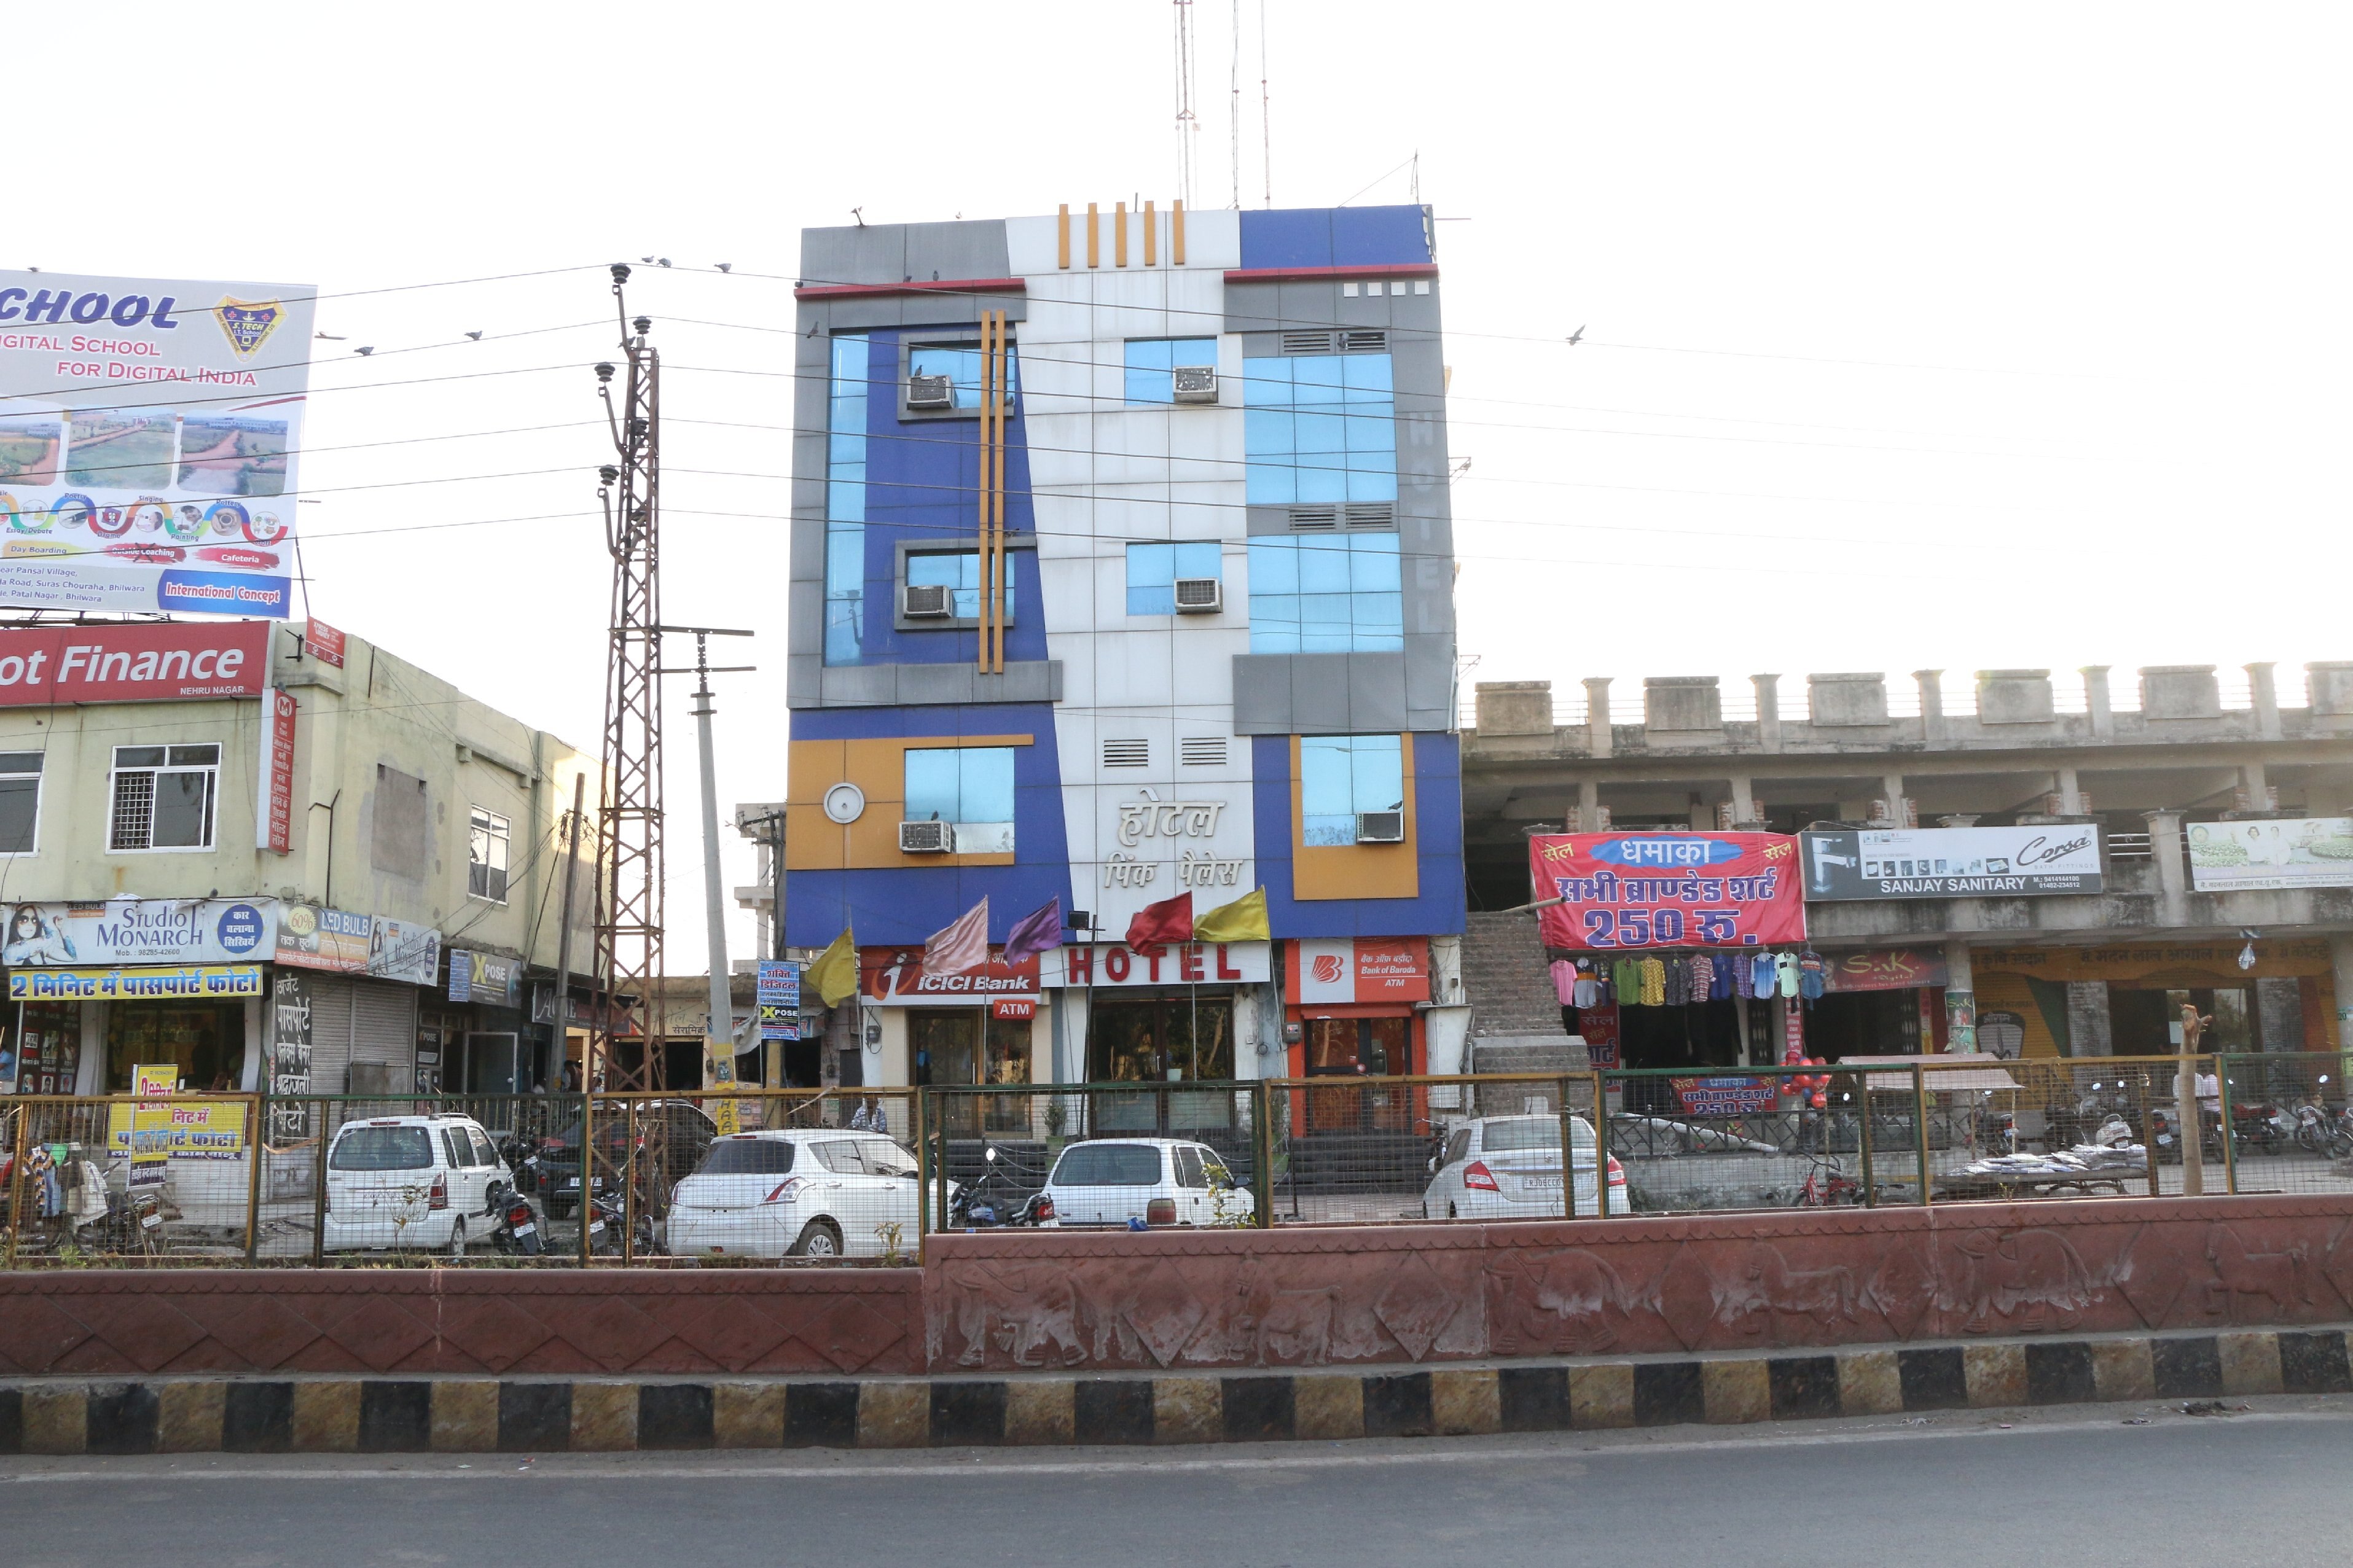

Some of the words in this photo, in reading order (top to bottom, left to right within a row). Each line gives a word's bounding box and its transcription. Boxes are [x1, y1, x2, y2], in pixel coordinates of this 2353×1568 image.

[58, 362, 101, 377] FOR
[108, 362, 191, 383] DIGITAL
[198, 367, 257, 386] INDIA
[171, 533, 199, 542] Painting
[221, 554, 259, 563] Cafeteria
[47, 568, 78, 577] Village,
[63, 582, 106, 592] Chouraha,
[166, 583, 234, 599] International
[238, 588, 281, 604] Concept
[34, 591, 59, 601] Nagar
[66, 593, 102, 602] Bhilwara
[58, 646, 244, 682] Finance
[180, 687, 211, 695] NEHRU
[213, 685, 245, 695] NAGAR
[1118, 787, 1227, 846] होटल
[1541, 842, 1575, 862] सेल
[1621, 840, 1711, 865] धमाका
[1763, 841, 1792, 860] सेल
[2016, 835, 2092, 867] Corsa
[1105, 850, 1158, 888] पिंक
[1179, 849, 1243, 886] पैलेस
[1555, 870, 1621, 903] सभी
[1881, 878, 1944, 894] SANJAY
[1948, 876, 2027, 892] SANITARY
[233, 910, 250, 921] कार
[291, 913, 313, 929] 60%
[321, 912, 340, 932] LED
[344, 916, 368, 935] BULB
[226, 924, 254, 934] चलाना
[1584, 909, 1684, 946] 250
[280, 935, 295, 946] तक
[472, 953, 506, 985] XPOSE
[1068, 945, 1241, 983] HOTEL
[11, 976, 27, 997] 2
[33, 972, 97, 996] मिनिट
[101, 971, 119, 996] में
[123, 970, 203, 995] पासपोर्ट
[207, 968, 259, 993] फोटो
[761, 980, 796, 989] डिजिटल
[917, 976, 969, 991] ICICI
[974, 975, 1030, 991] Bank
[761, 1006, 798, 1018] XPOSE
[1000, 1004, 1029, 1015] ATM
[1709, 1078, 1747, 1087] धमाका
